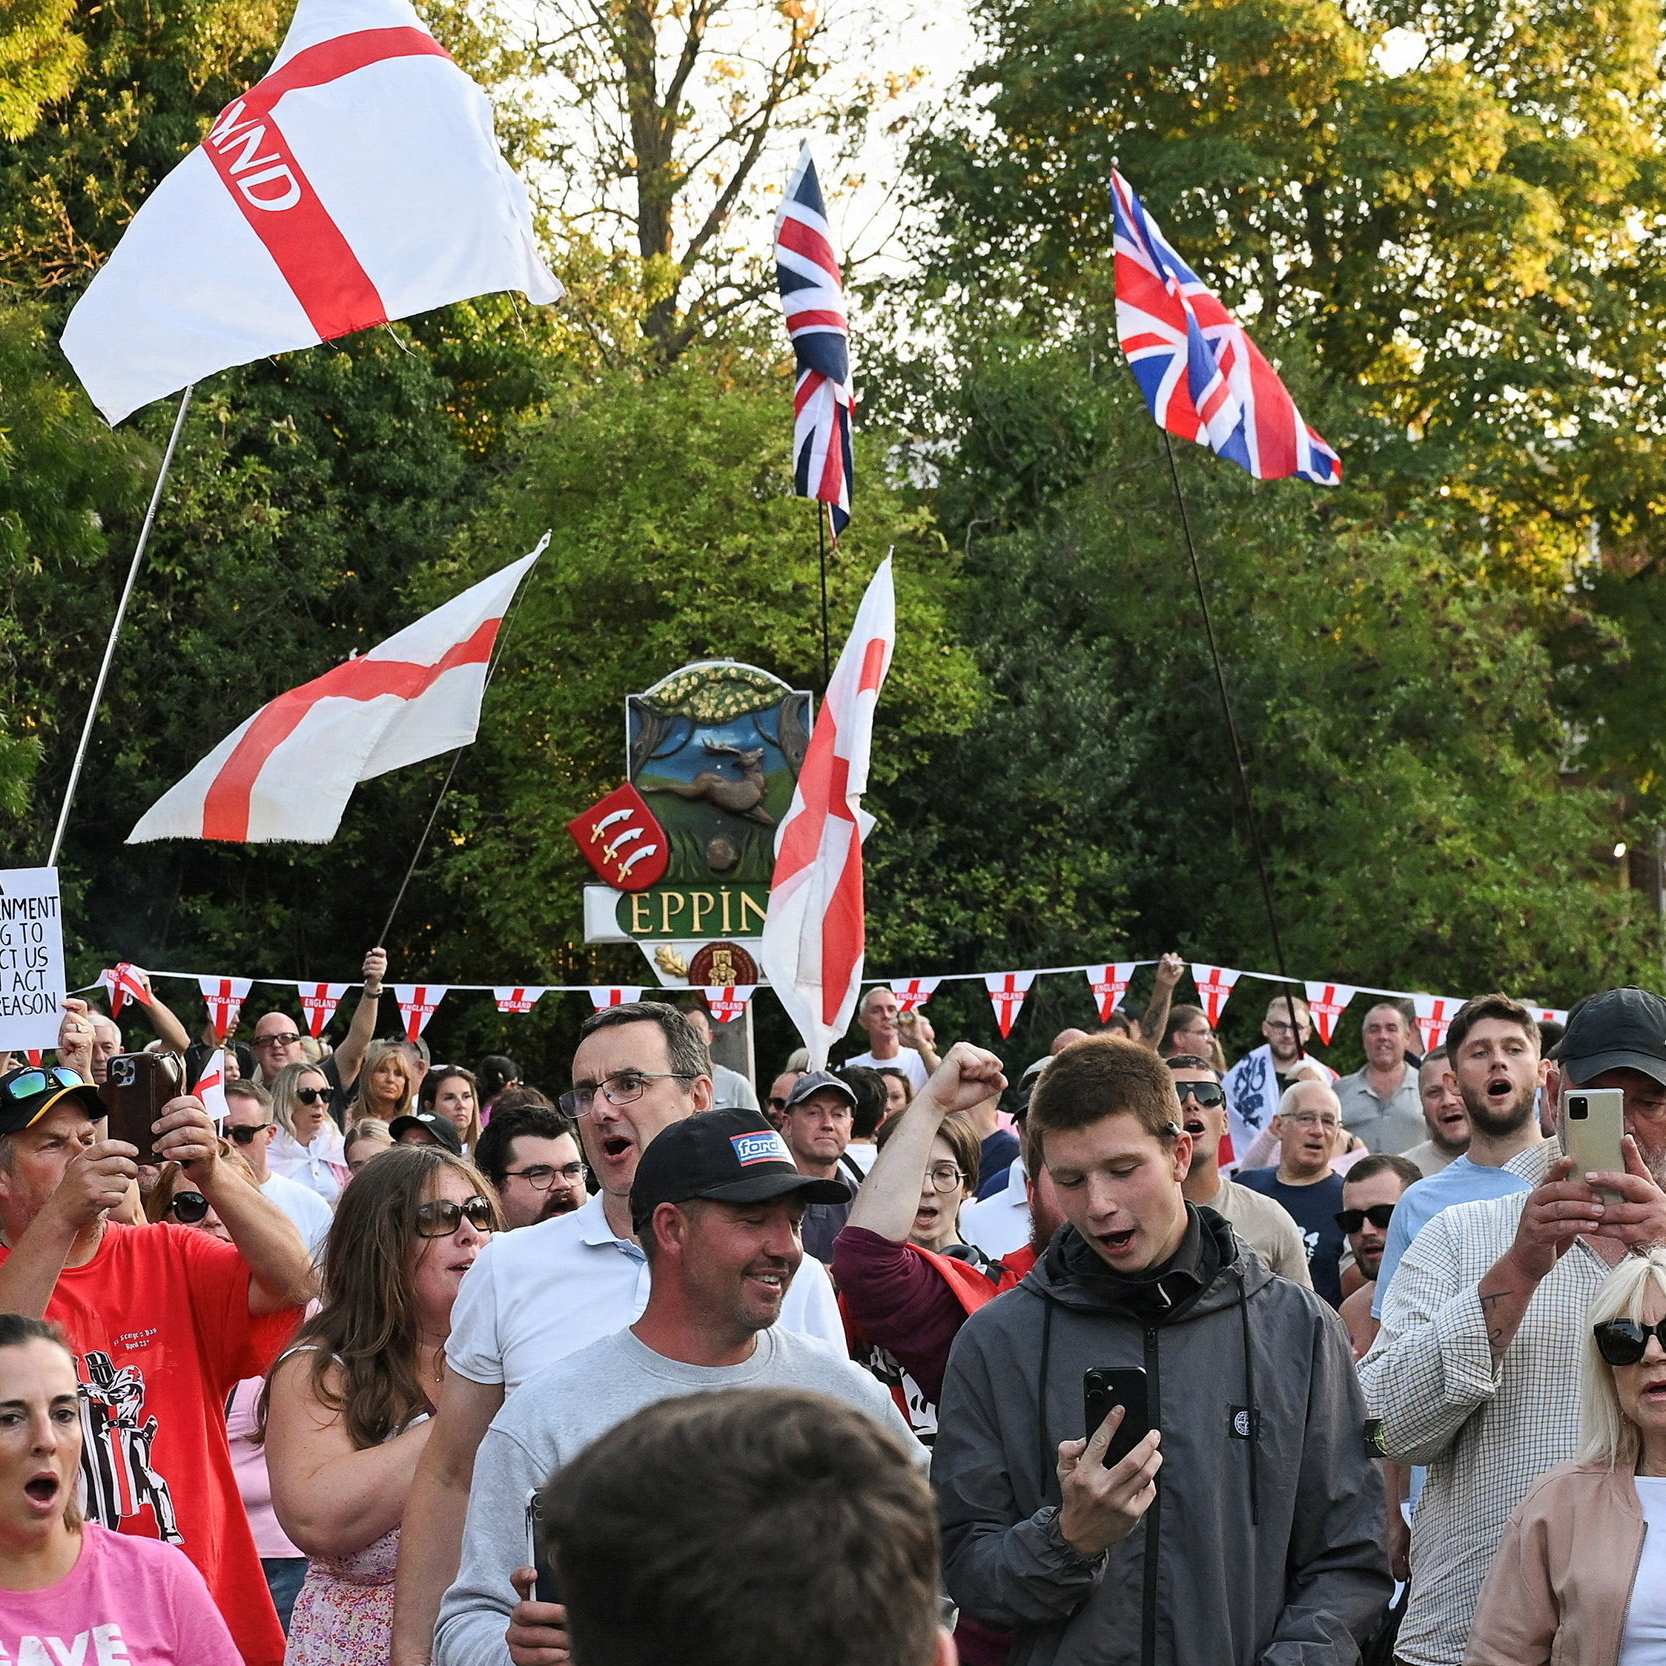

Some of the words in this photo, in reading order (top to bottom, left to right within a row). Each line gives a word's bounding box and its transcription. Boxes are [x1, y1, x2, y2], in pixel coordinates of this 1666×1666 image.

[629, 890, 770, 933] EPPIN
[19, 922, 43, 944] TO
[25, 946, 48, 968] US
[13, 970, 46, 992] ACT
[208, 995, 241, 1005] ENGLAND
[305, 998, 337, 1009] ENGLAND
[500, 1000, 531, 1009] ENGLAND
[712, 1001, 744, 1011] ENGLAND
[402, 1003, 434, 1014] ENGLAND
[737, 1139, 779, 1157] ford
